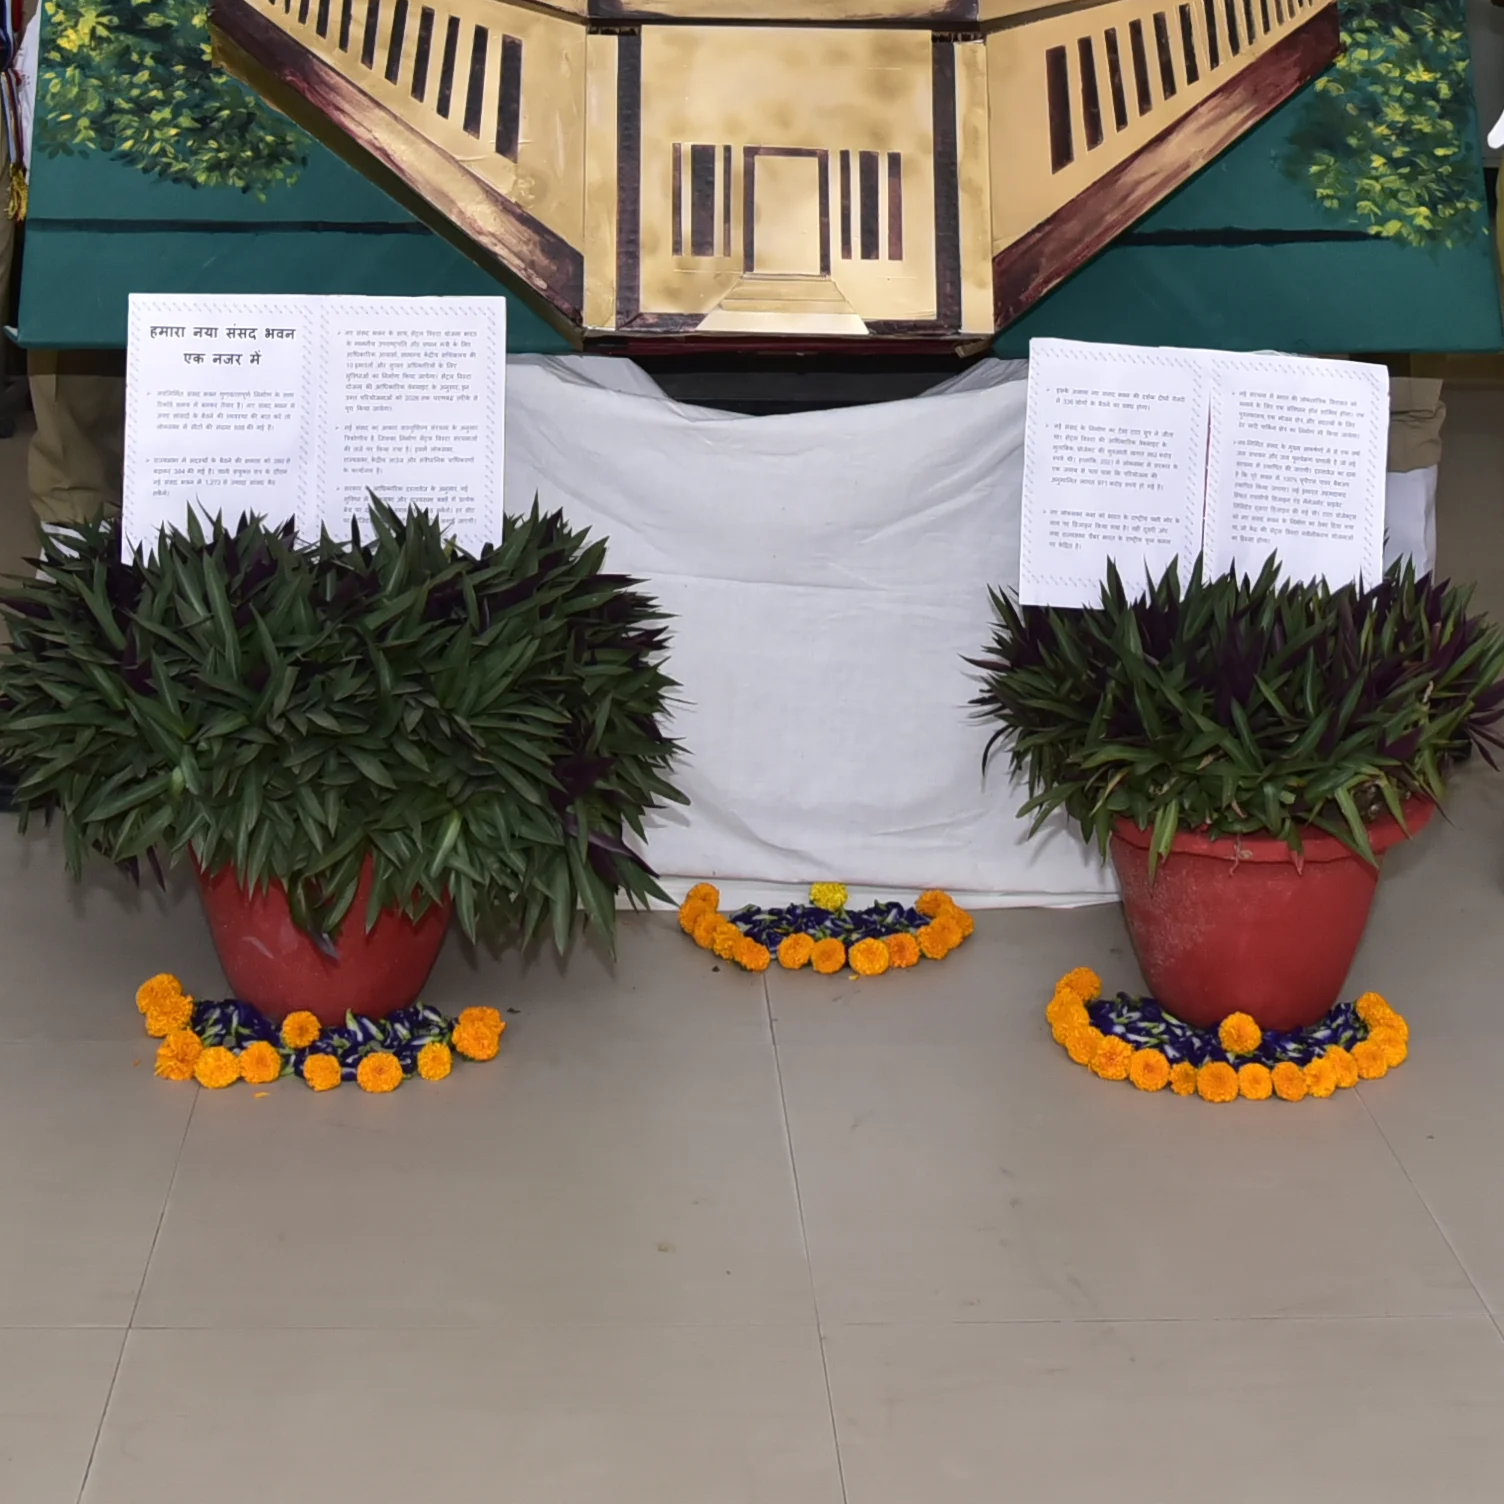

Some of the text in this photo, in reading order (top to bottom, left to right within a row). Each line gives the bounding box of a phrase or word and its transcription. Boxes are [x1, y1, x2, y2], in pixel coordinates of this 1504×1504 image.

[150, 323, 297, 341] हमारा नया संसद भवन
[183, 349, 262, 366] एक नजर में
